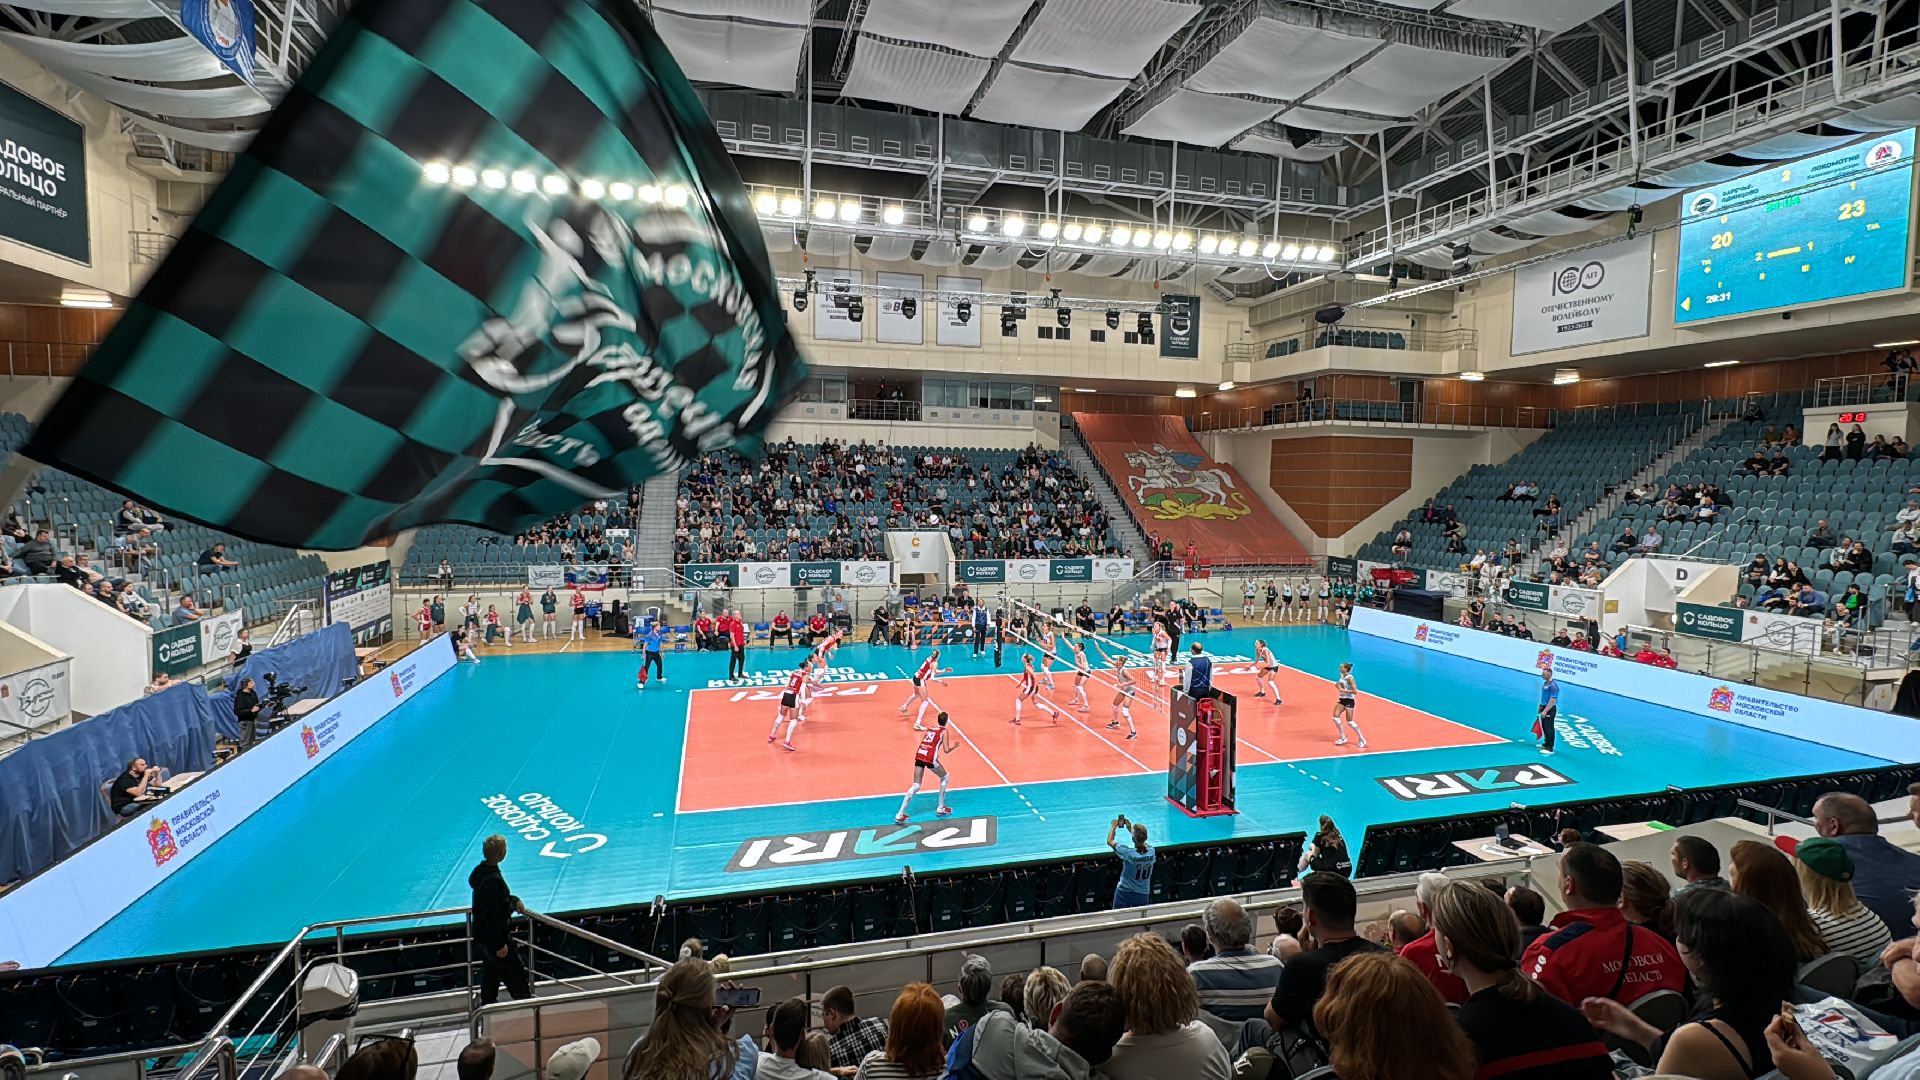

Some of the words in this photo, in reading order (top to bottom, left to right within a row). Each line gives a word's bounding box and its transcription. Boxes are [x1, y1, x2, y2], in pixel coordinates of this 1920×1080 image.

[1838, 199, 1866, 220] 23
[1711, 231, 1733, 250] 20
[1541, 293, 1614, 314] ОТЕЧЕСТВЕННОМУ
[1552, 307, 1600, 322] ВОЛЕЙБОЛУ
[1676, 568, 1688, 580] D
[1697, 612, 1735, 624] САДОВОЕ
[1697, 619, 1729, 630] КОЛЬЦО
[789, 677, 798, 687] 8
[1735, 701, 1785, 717] МОСКОВСКОЙ
[1737, 694, 1799, 713] ПРАВИТЕЛЬСТВО
[1734, 708, 1767, 721] ОБЛАСТИ
[922, 731, 937, 743] 29
[1384, 764, 1568, 799] PARI
[171, 789, 221, 825] ПРАВИТЕЛЬСТВО
[518, 792, 585, 833] КОЛЬЦО
[175, 804, 216, 837] МОСКОВСКОЙ
[480, 793, 551, 841] САДОВОЕ
[180, 823, 208, 848] ОБЛАСТИ
[738, 818, 988, 868] PARI
